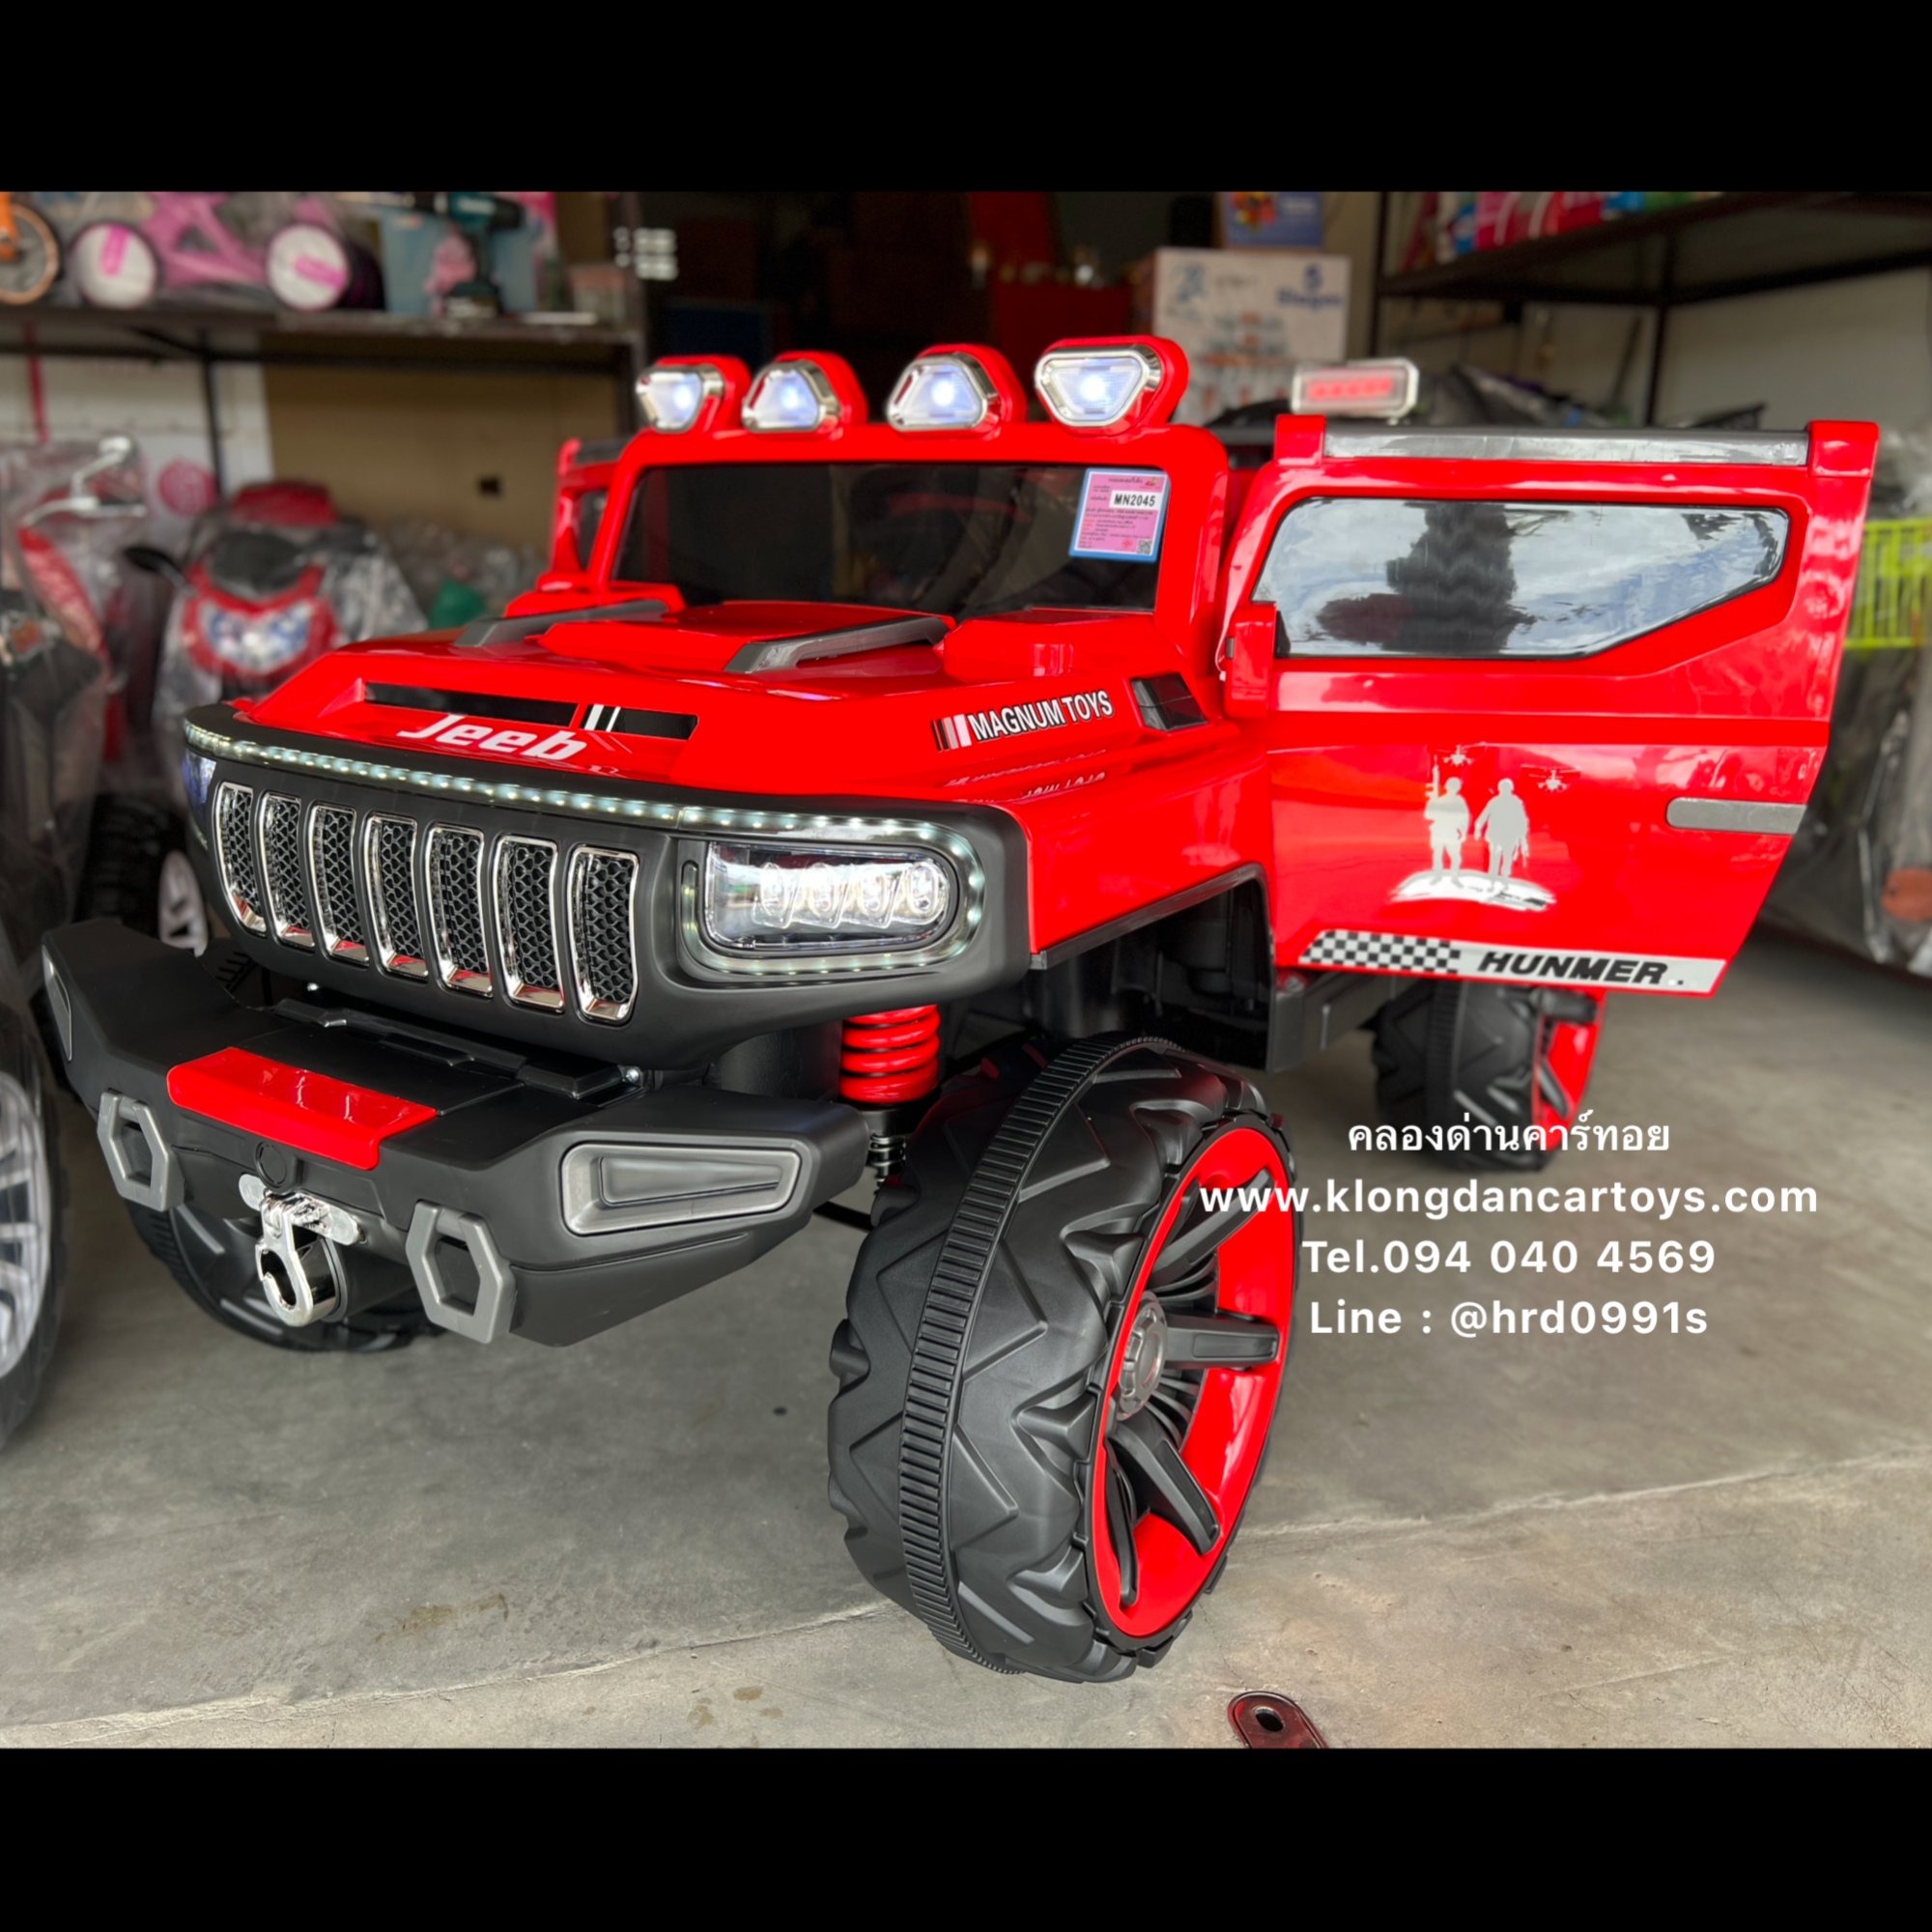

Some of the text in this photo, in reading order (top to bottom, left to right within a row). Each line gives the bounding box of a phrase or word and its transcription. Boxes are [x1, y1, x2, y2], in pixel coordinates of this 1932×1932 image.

[1114, 494, 1155, 507] MN2045
[396, 714, 587, 760] Jeeb
[967, 690, 1113, 742] MAGNUM TOYS
